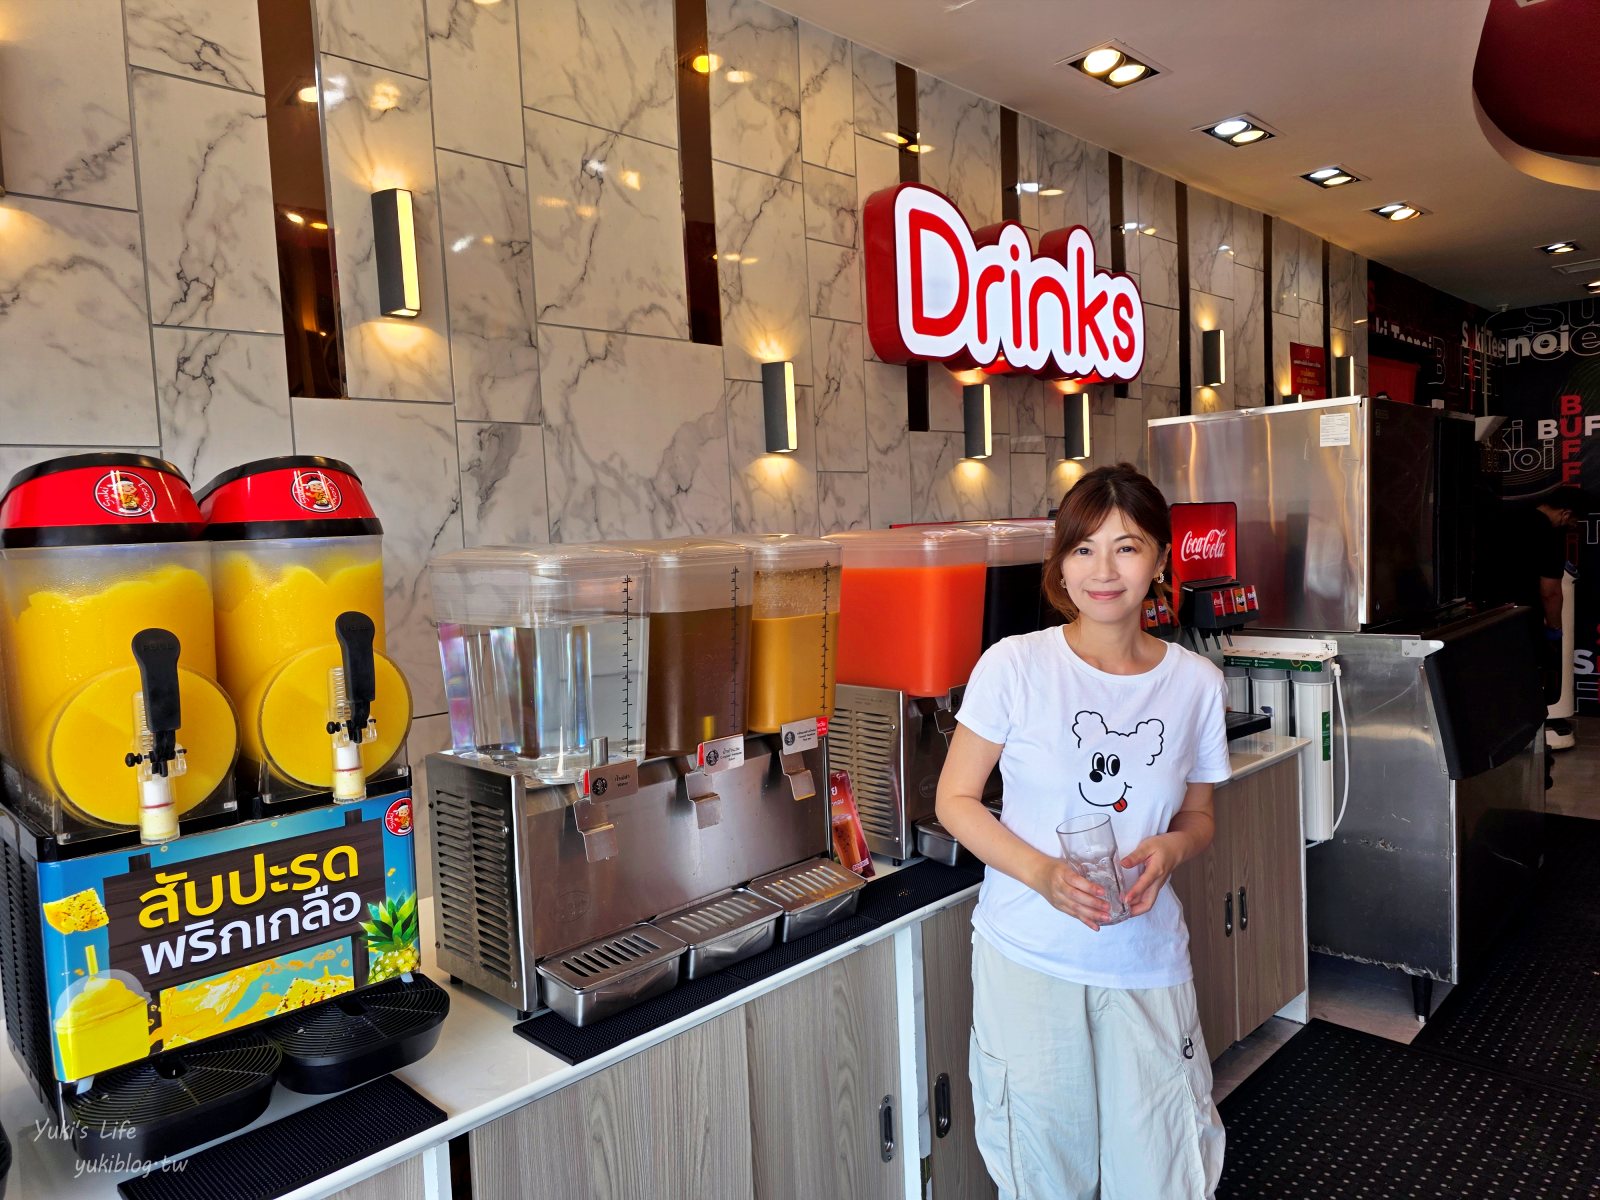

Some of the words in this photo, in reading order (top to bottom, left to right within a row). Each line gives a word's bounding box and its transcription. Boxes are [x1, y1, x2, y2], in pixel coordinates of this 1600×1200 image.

[908, 207, 1137, 363] Drinks
[1559, 394, 1584, 489] BUFF
[1180, 528, 1228, 562] Coca-Cola
[138, 845, 359, 929] สับปะรด
[141, 884, 362, 975] พริกเกลือ
